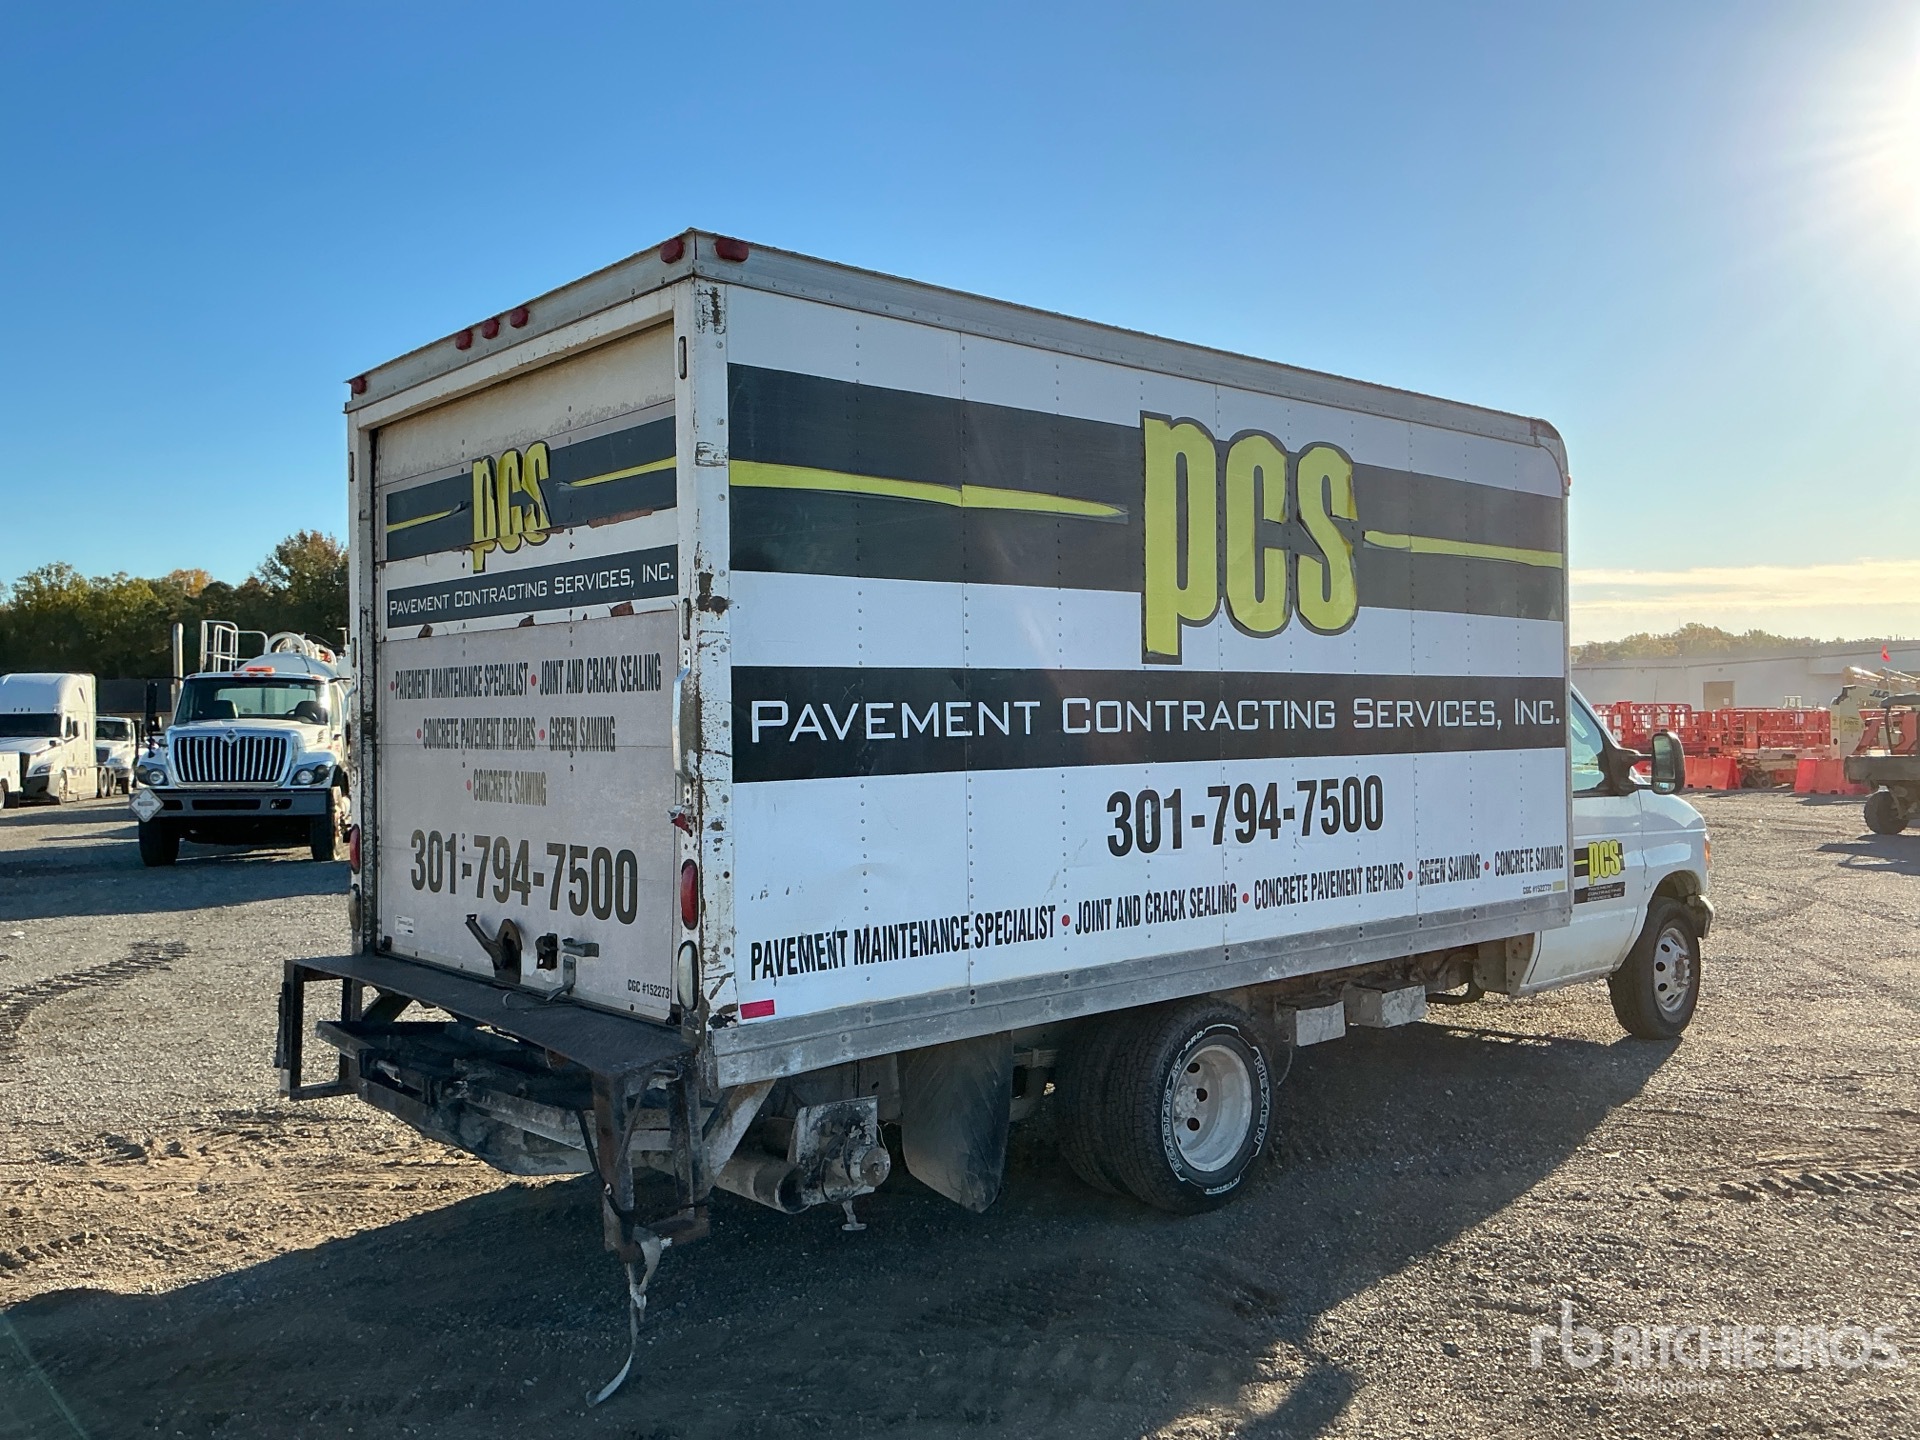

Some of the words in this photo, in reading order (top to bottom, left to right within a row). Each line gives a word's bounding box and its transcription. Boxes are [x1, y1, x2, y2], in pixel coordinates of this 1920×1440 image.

[390, 594, 450, 616] PAVEMENT
[454, 580, 548, 608] CONTRACTING
[554, 568, 635, 595] SERVICES,
[642, 562, 675, 584] INC.
[394, 668, 430, 700] PAVEMENT
[431, 665, 483, 699] MAINTENANCE
[484, 662, 529, 697] SPECIALIST
[540, 660, 564, 696] JOINT
[566, 658, 584, 694] AND
[586, 655, 618, 694] CRACK
[620, 652, 662, 693] SEALING
[423, 717, 459, 751] CONCRETE
[460, 717, 501, 751] PAVEMENT
[502, 716, 536, 751] REPAIRS
[549, 716, 578, 752] GREEN
[580, 715, 616, 753] SAWING
[751, 699, 1041, 744] PAVEMENT
[1062, 697, 1336, 734] CONTRACTING
[1353, 697, 1503, 731] SERVICES,
[1514, 698, 1561, 726] INC.
[473, 768, 513, 804] CONCRETE
[514, 770, 547, 807] SAWING
[1106, 774, 1384, 857] 301-794-7500
[410, 828, 639, 925] 301-794-7500
[1418, 857, 1446, 887] GREEN
[1448, 853, 1481, 883] SAWING
[1494, 848, 1534, 877] CONCRETE
[1535, 844, 1564, 871] SAWING
[1075, 898, 1112, 935] JOINT
[1116, 894, 1141, 929] AND
[1145, 889, 1187, 925] CRACK
[1189, 882, 1237, 920] SEALING
[1254, 873, 1308, 911] CONCRETE
[1311, 867, 1363, 902] PAVEMENT
[1366, 862, 1405, 894] REPAIRS
[751, 930, 848, 981] PAVEMENT
[854, 914, 970, 966] MAINTENANCE
[974, 904, 1056, 950] SPECIALIST
[627, 978, 641, 993] CGC
